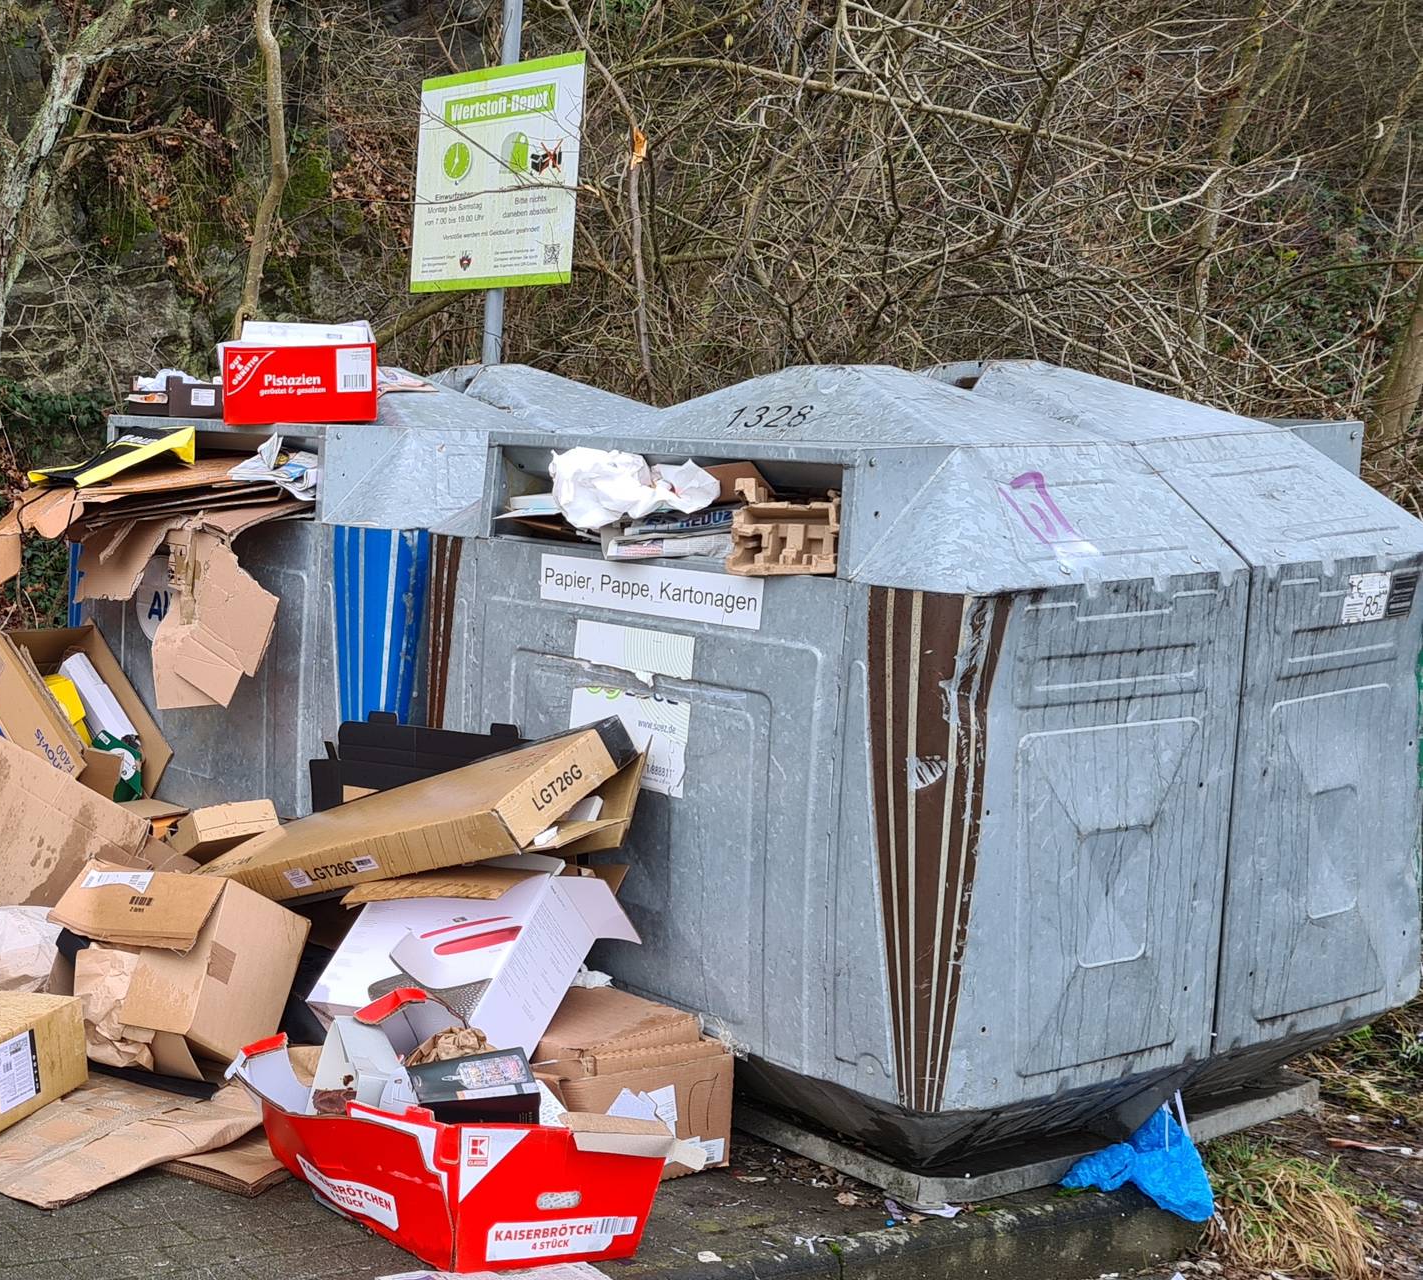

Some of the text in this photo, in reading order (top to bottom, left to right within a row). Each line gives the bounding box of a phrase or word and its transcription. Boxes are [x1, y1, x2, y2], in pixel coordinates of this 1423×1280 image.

[451, 90, 549, 121] Wertstoff-Depot
[229, 354, 243, 370] GUT
[231, 355, 260, 385] GÜNSTIG
[259, 386, 326, 397] geröstet & gesalzen
[264, 373, 321, 387] Pistazien
[726, 404, 814, 428] 1328
[545, 567, 758, 614] Papier, Pappe, Kartonagen
[56, 744, 75, 773] F400
[532, 764, 583, 811] LGT26G
[305, 860, 359, 882] LGT26G
[539, 1239, 569, 1250] STÜCK
